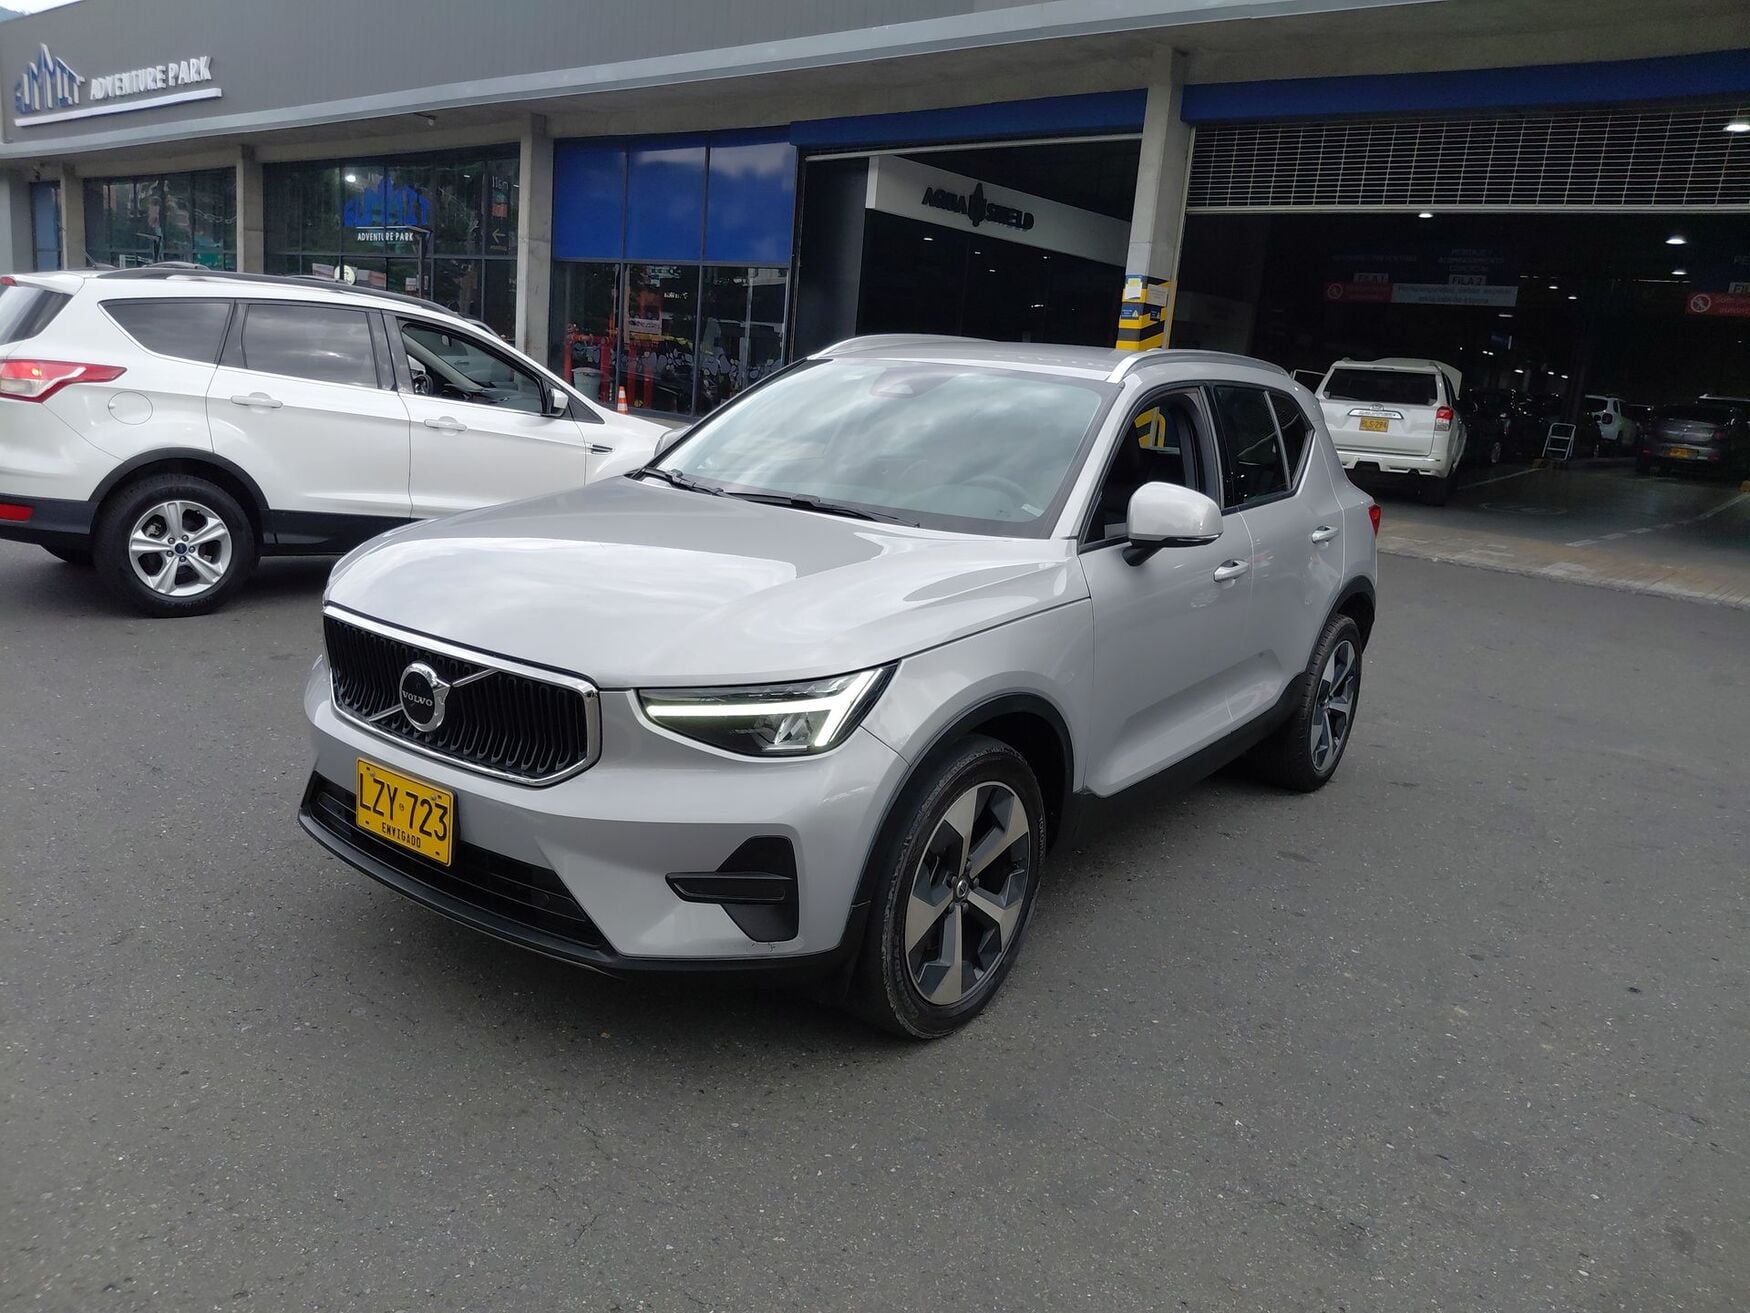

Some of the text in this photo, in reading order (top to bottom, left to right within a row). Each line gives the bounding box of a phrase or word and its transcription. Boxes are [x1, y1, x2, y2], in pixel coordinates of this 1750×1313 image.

[90, 55, 212, 100] ADVENTURE PARK
[357, 232, 414, 242] ADVENTURE PARK
[402, 690, 433, 707] VOLVO
[381, 822, 422, 849] ENVIGADO
